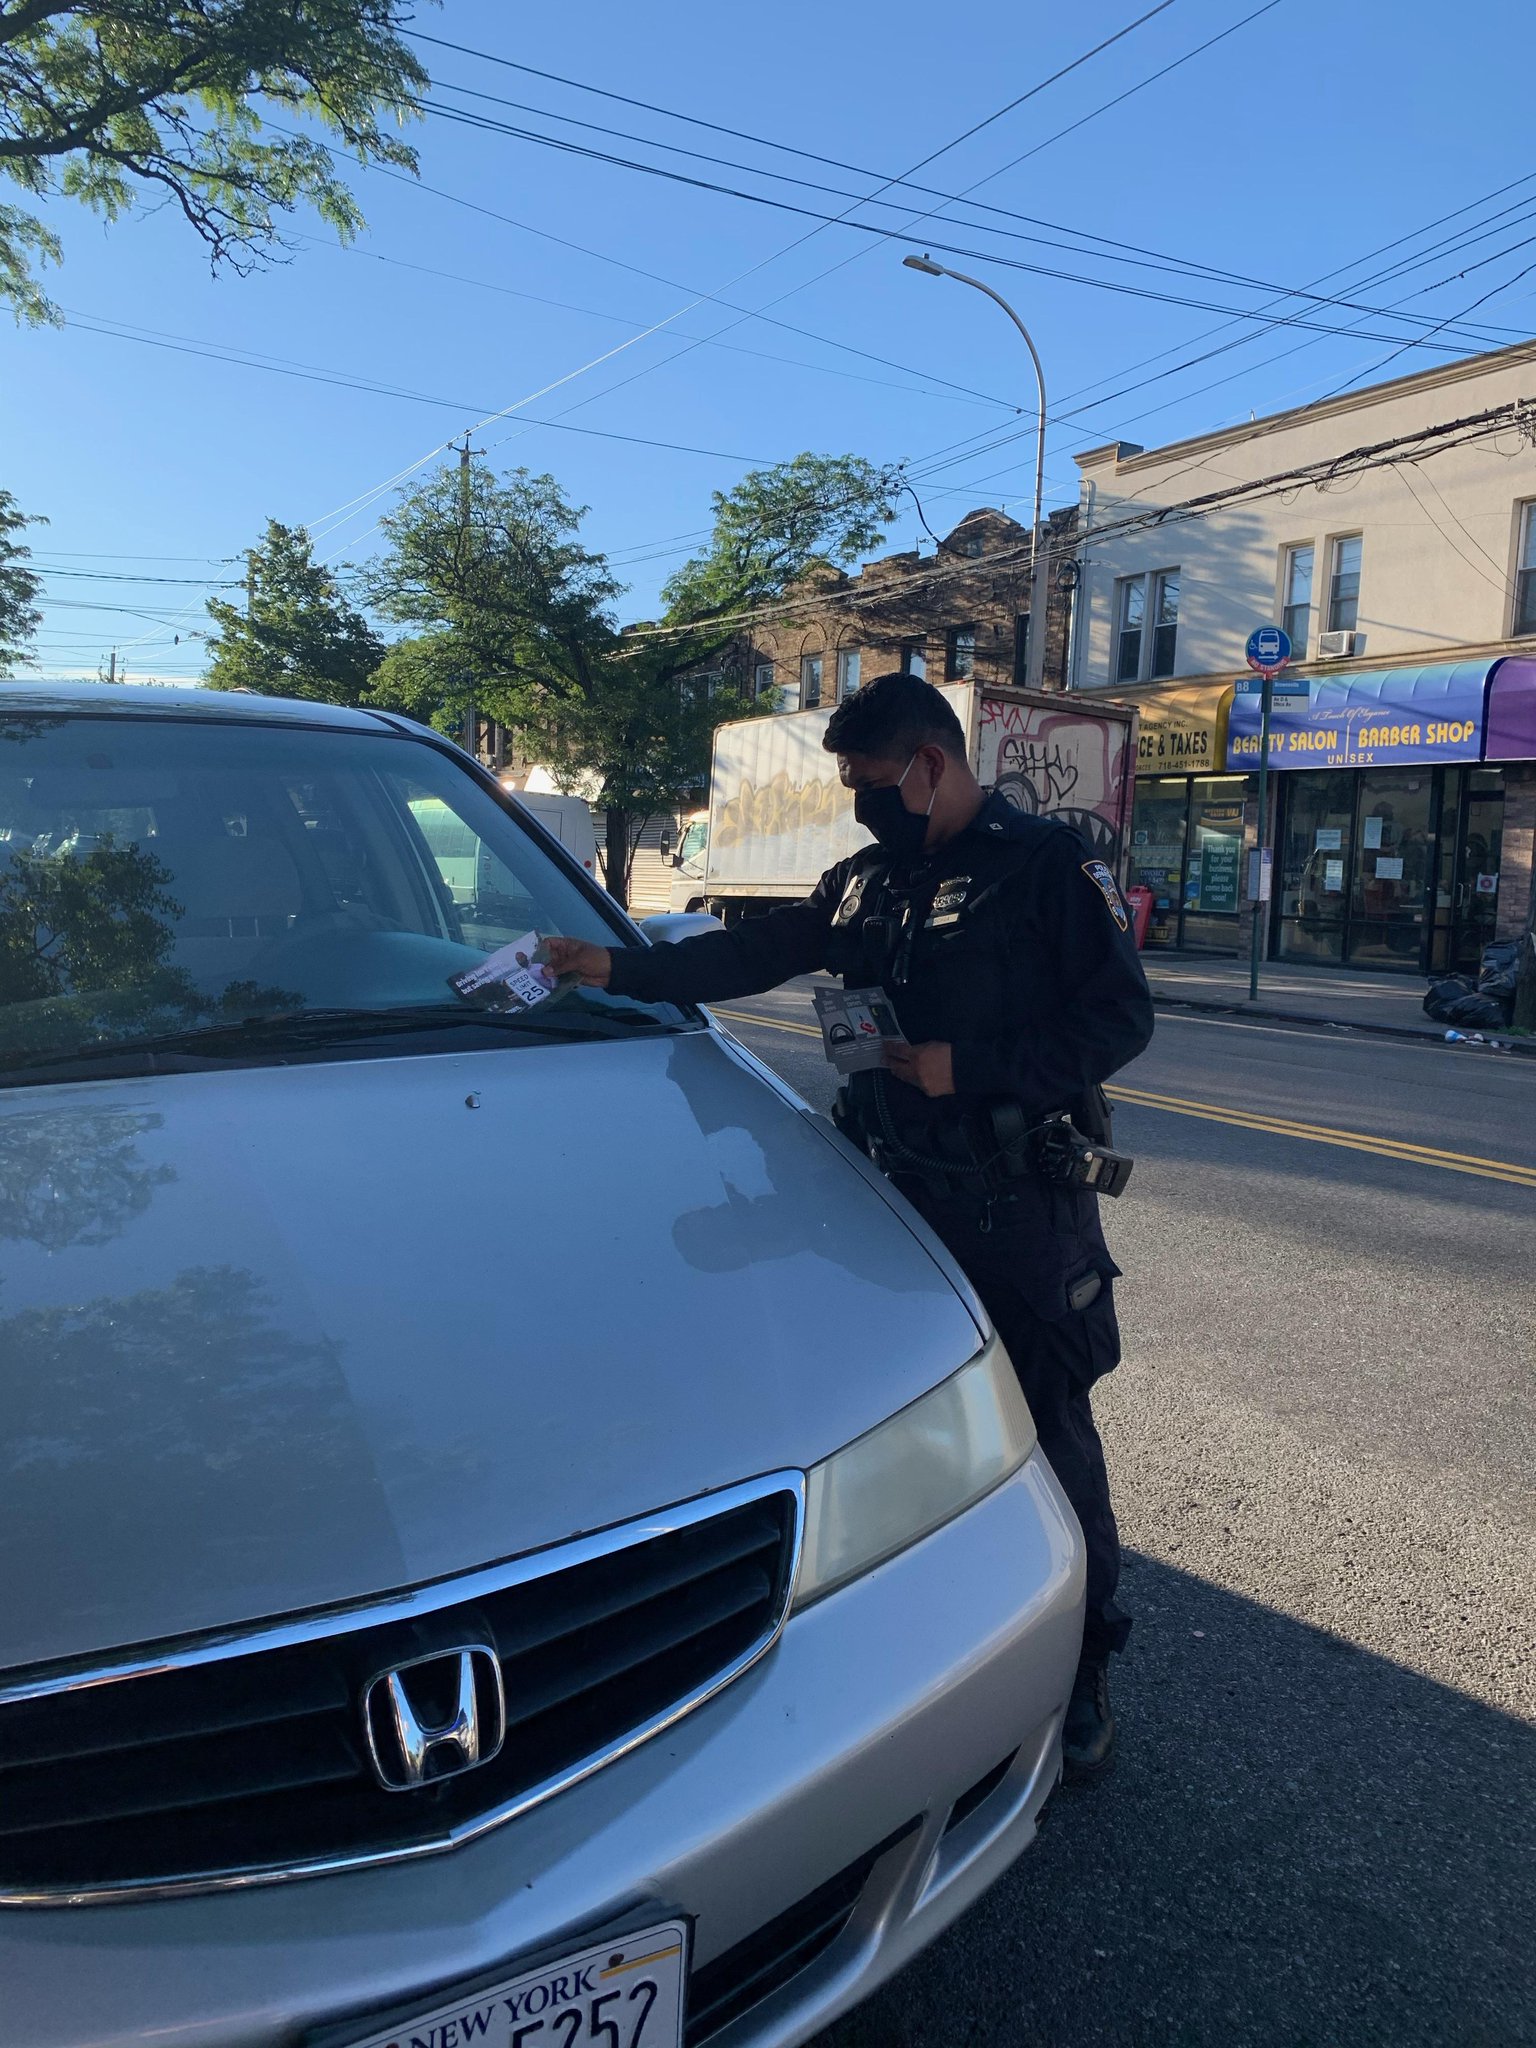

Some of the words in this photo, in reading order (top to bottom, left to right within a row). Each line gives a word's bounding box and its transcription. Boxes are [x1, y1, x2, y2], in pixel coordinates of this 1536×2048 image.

[1236, 681, 1249, 692] B8
[1143, 721, 1172, 731] AGENCY
[1173, 720, 1188, 729] INC.
[1288, 730, 1338, 752] SALON
[1358, 724, 1421, 748] BARBER
[1425, 720, 1475, 744] SHOP
[1157, 734, 1165, 757] &
[1170, 730, 1208, 756] TAXES
[1327, 752, 1374, 765] UNISEX
[1207, 844, 1225, 853] Thank
[1225, 846, 1236, 856] you
[509, 973, 529, 987] SPEED
[516, 980, 532, 992] LIMIT
[521, 985, 544, 1002] 25
[409, 2005, 496, 2048] NEW
[503, 1965, 598, 2025] YORK
